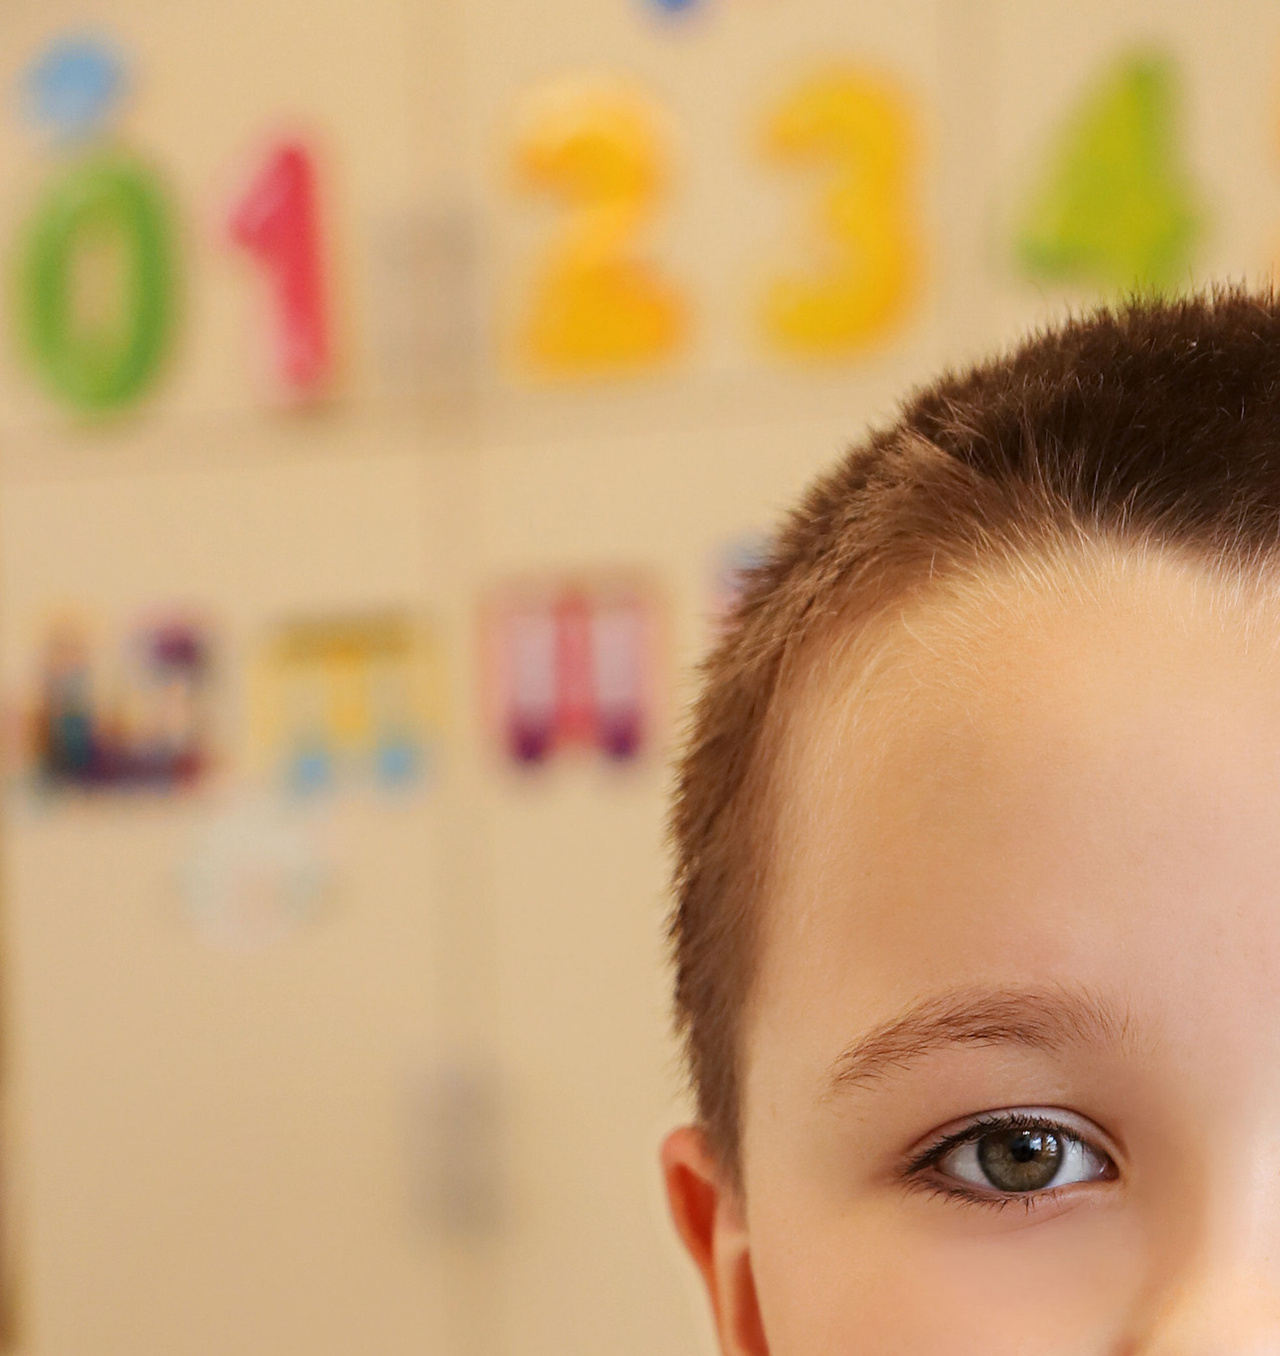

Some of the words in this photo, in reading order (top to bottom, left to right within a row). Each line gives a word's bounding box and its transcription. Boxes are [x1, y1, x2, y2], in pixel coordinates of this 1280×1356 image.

[222, 128, 335, 402] 1
[508, 72, 690, 378] 2
[758, 65, 915, 355] 3
[1008, 42, 1205, 308] 4
